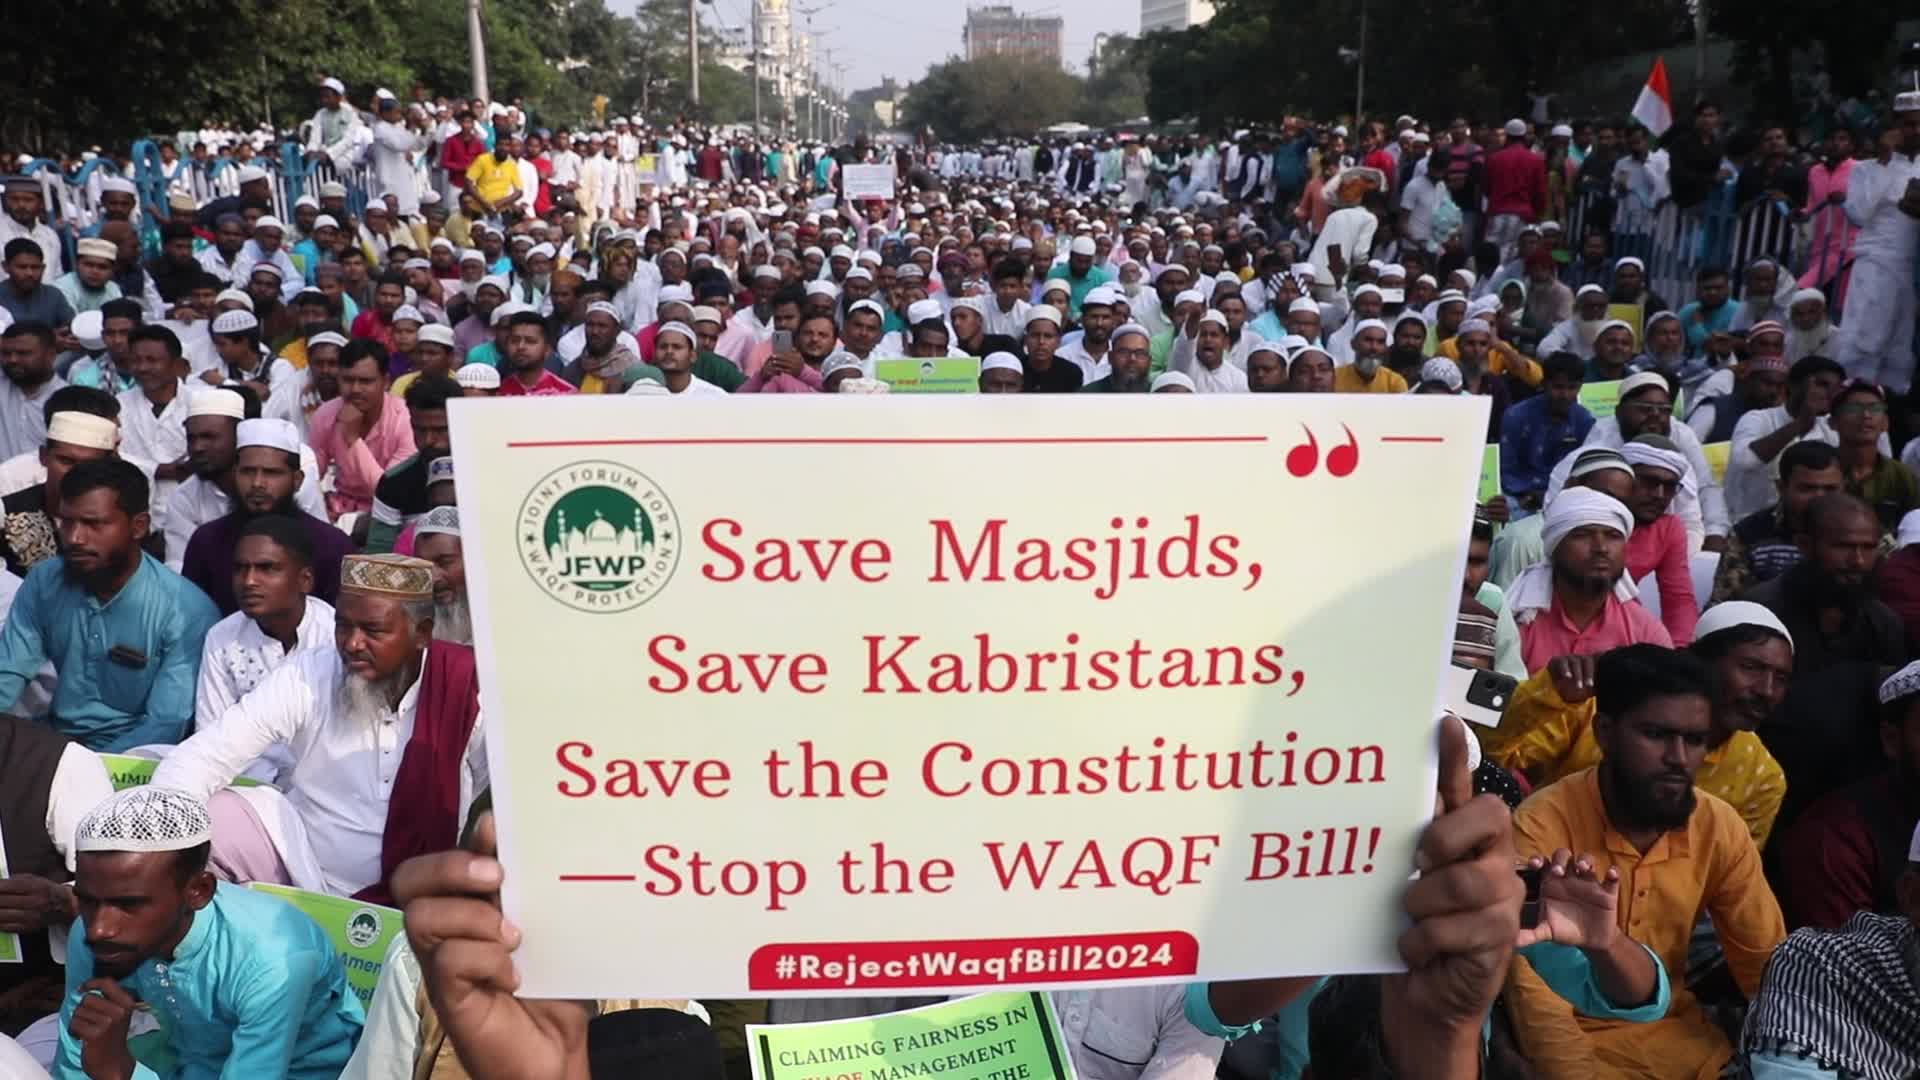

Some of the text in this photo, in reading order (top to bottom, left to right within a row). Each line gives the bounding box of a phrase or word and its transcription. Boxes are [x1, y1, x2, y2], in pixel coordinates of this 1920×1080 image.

[524, 468, 670, 527] JOINT FORUM FOR
[528, 546, 673, 606] WAQF PROTECTION
[558, 555, 646, 577] JFWP
[703, 515, 1262, 600] Save Masjids,
[648, 633, 1305, 695] Save Kabristans,
[556, 735, 1384, 798] Save the Constitution
[840, 843, 955, 896] the
[984, 835, 1220, 896] WAQF
[1246, 828, 1382, 881] Bill!
[775, 943, 1173, 985] #RejectWaqfBill2024
[779, 1006, 1029, 1066] CLAIMING FAIRNESS IN
[870, 1038, 1017, 1080] MANAGEMENT
